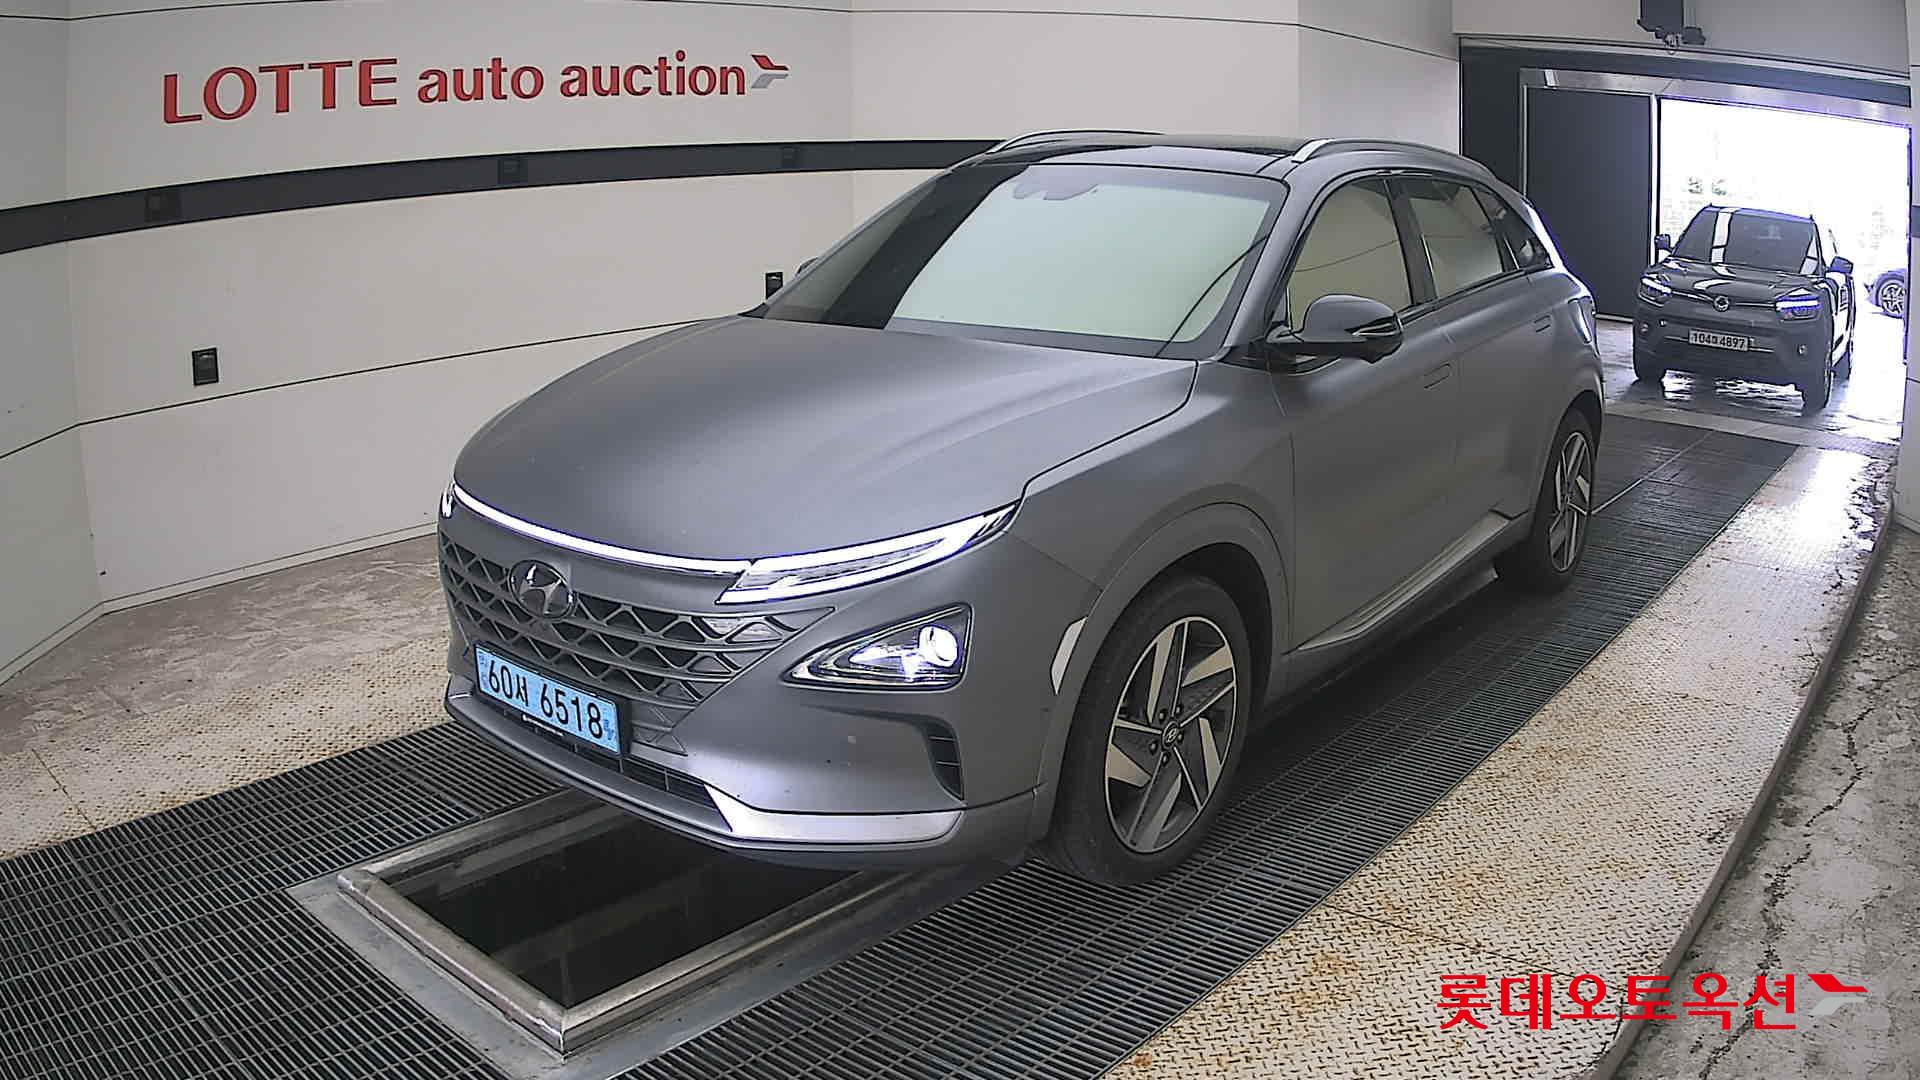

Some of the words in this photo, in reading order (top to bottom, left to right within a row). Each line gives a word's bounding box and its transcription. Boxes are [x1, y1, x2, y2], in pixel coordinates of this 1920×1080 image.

[164, 58, 397, 124] LOTTE
[417, 57, 544, 104] auto
[560, 50, 745, 97] auction
[1720, 336, 1745, 349] 4897
[488, 660, 529, 707] 60서
[540, 683, 603, 739] 6518
